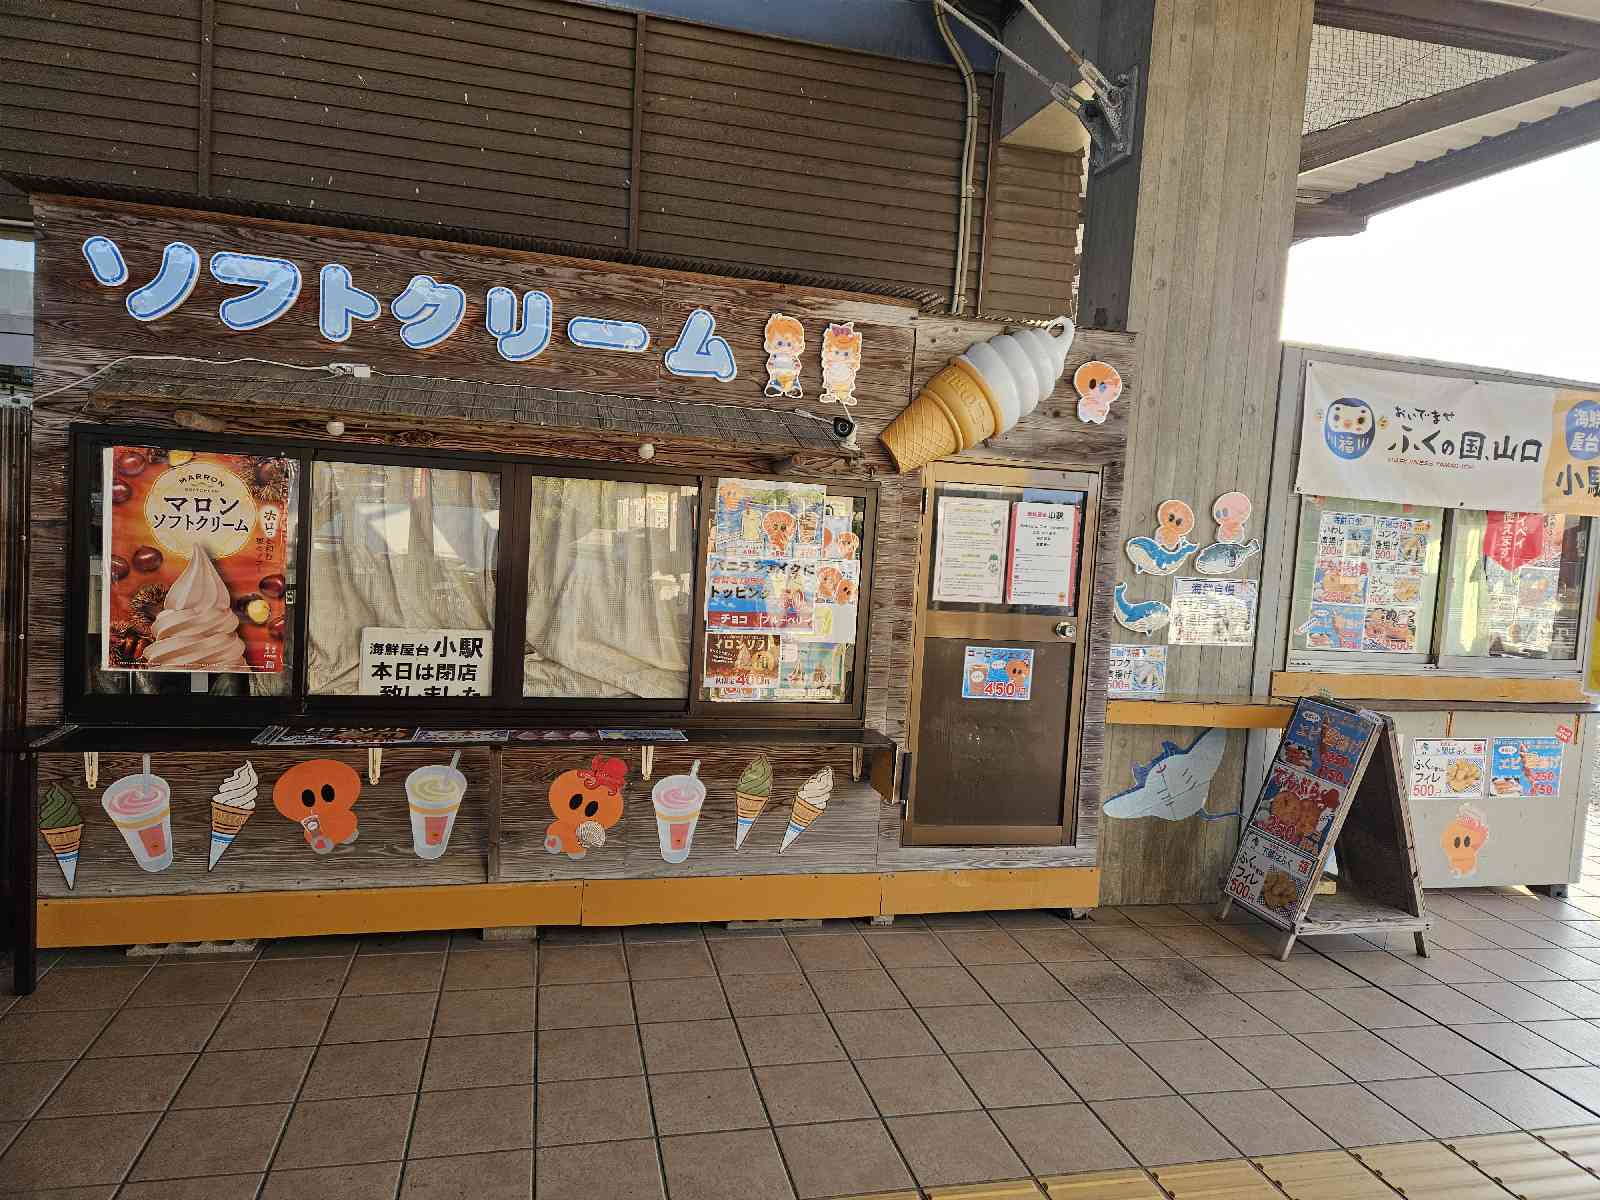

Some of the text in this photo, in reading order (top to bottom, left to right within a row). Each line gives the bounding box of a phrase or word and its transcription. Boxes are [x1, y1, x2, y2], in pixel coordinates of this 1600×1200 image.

[83, 236, 737, 383] ソフトクリーム
[1395, 406, 1455, 424] おいでませ
[1387, 425, 1543, 462] ふくの国、山口
[178, 473, 224, 488] MARRON
[163, 497, 240, 516] マロン
[153, 513, 249, 533] ソフトクリーム
[720, 613, 748, 625] チョコ
[369, 636, 484, 659] 海鮮屋台小駅
[371, 662, 478, 681] 本日は閉店
